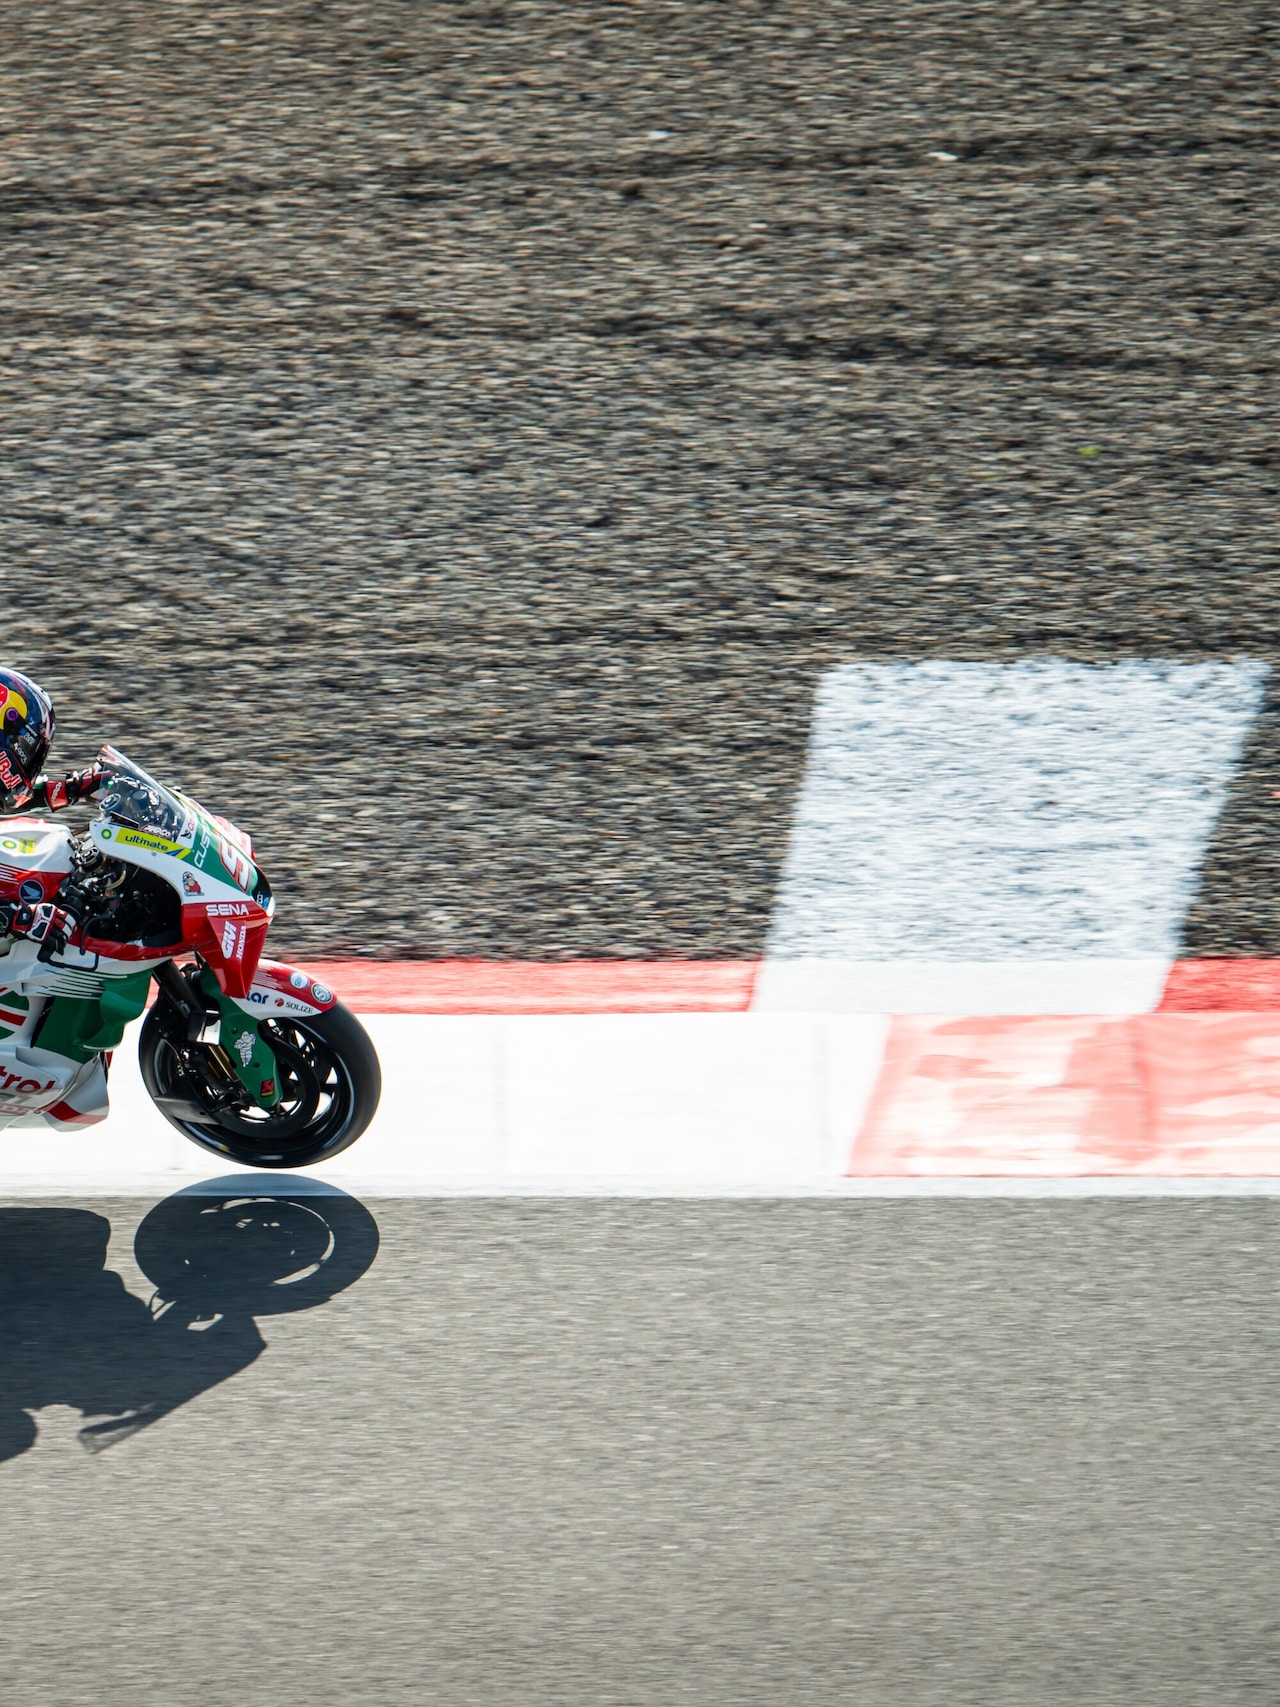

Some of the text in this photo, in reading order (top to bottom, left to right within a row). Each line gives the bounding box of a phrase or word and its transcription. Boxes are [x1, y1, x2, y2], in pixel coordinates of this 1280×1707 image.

[124, 834, 170, 852] ultimate
[205, 903, 250, 917] SENA
[221, 920, 238, 960] GIVI
[236, 924, 247, 960] HONDA
[285, 1000, 314, 1015] SOLIZE
